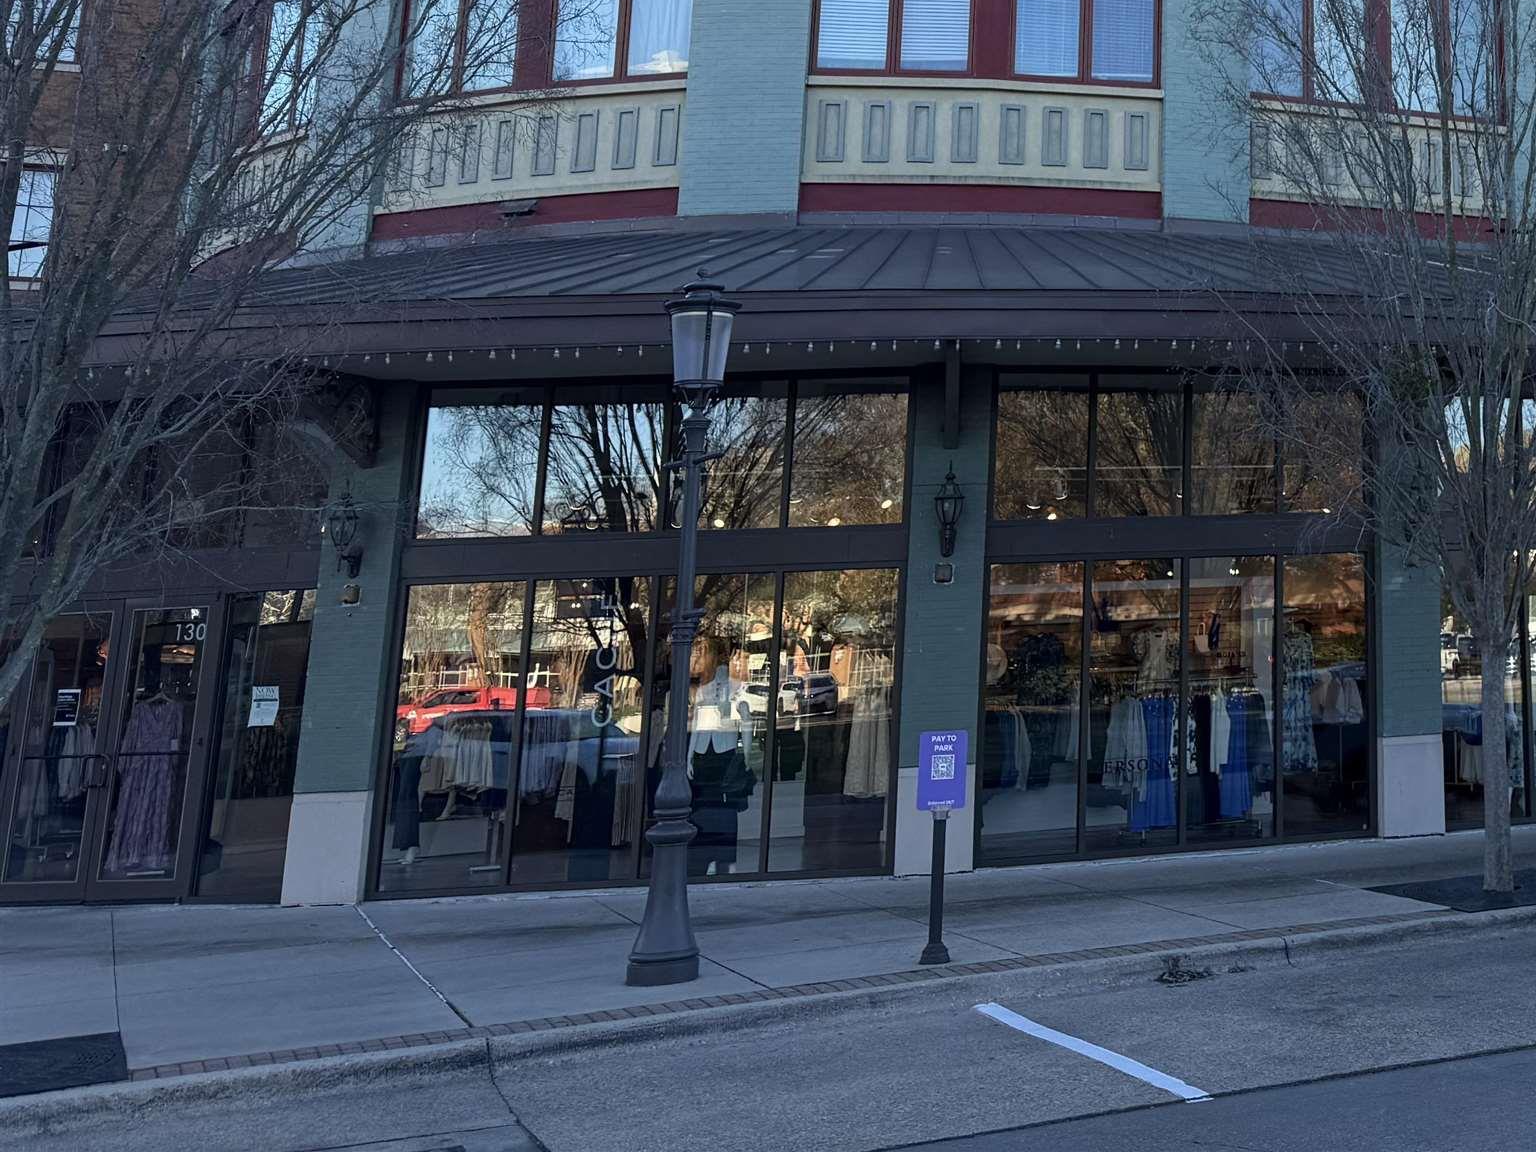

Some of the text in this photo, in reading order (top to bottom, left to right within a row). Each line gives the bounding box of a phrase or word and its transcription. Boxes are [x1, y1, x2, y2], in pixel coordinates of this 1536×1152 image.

[176, 623, 206, 641] 130
[931, 734, 957, 743] PAY TO
[934, 744, 953, 752] PARK
